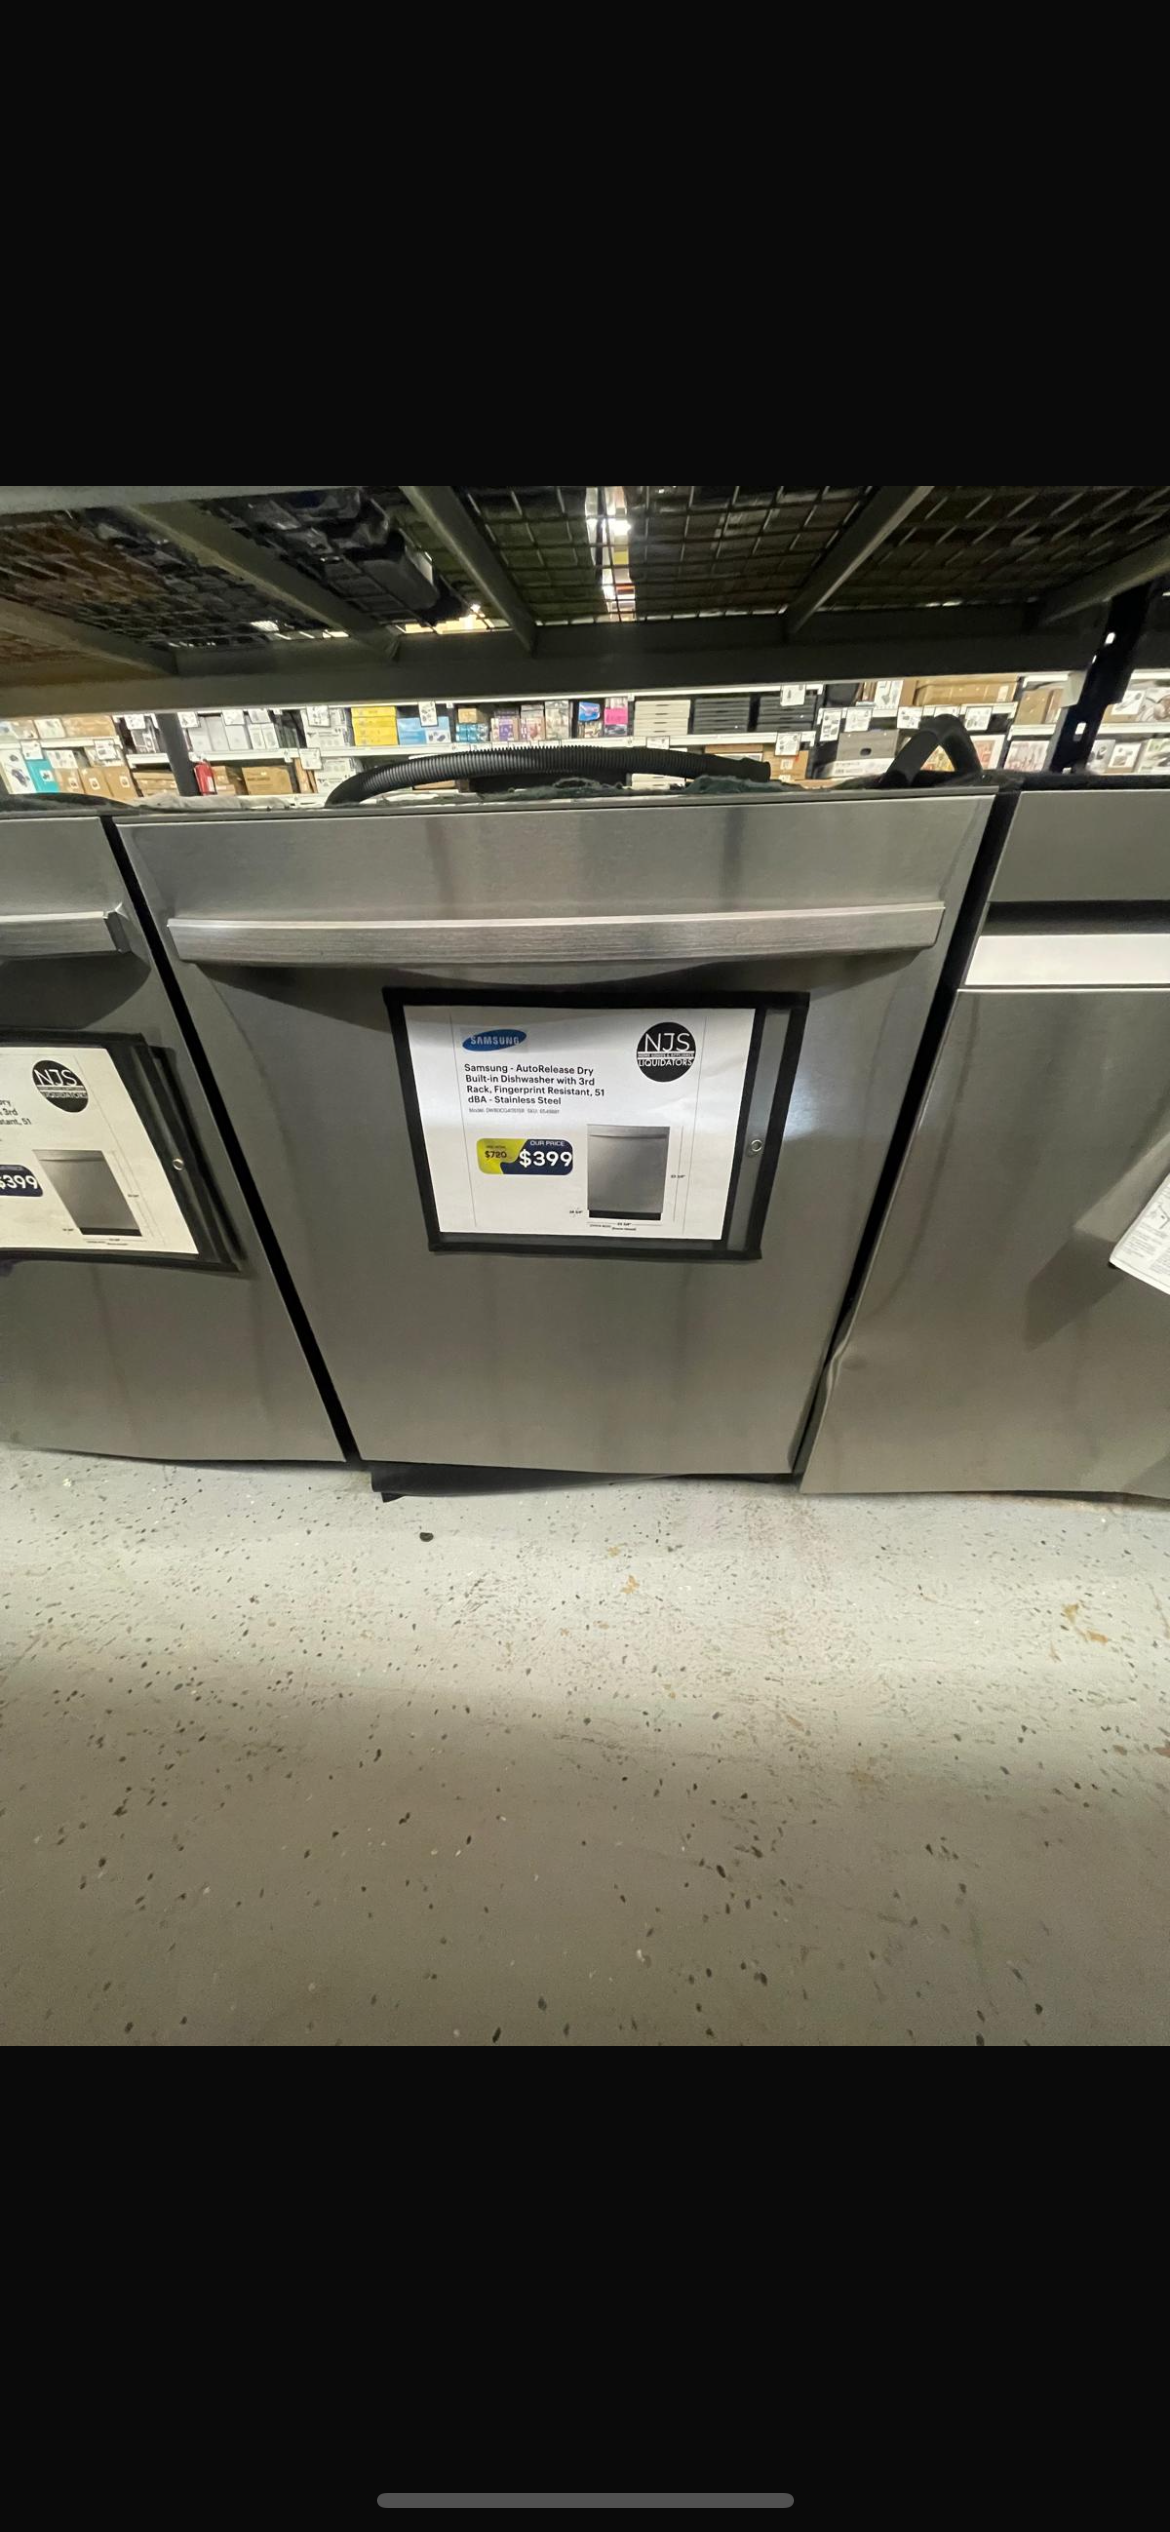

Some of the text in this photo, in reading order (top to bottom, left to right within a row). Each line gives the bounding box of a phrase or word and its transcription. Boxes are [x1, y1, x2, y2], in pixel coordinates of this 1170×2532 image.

[470, 1036, 520, 1045] SAMSUNG
[644, 1032, 690, 1052] NJS
[464, 1064, 508, 1073] Samsung
[516, 1064, 574, 1074] AutoRelease
[577, 1066, 594, 1076] Dry
[34, 1069, 77, 1086] NJS
[466, 1074, 595, 1086] Built-in Dishwasher with 3rd
[467, 1086, 492, 1094] Rack,
[494, 1086, 545, 1095] Fingerprint
[548, 1087, 593, 1097] Resistant,
[494, 1096, 536, 1104] Stainless
[538, 1097, 562, 1105] Steel
[520, 1149, 572, 1168] $399
